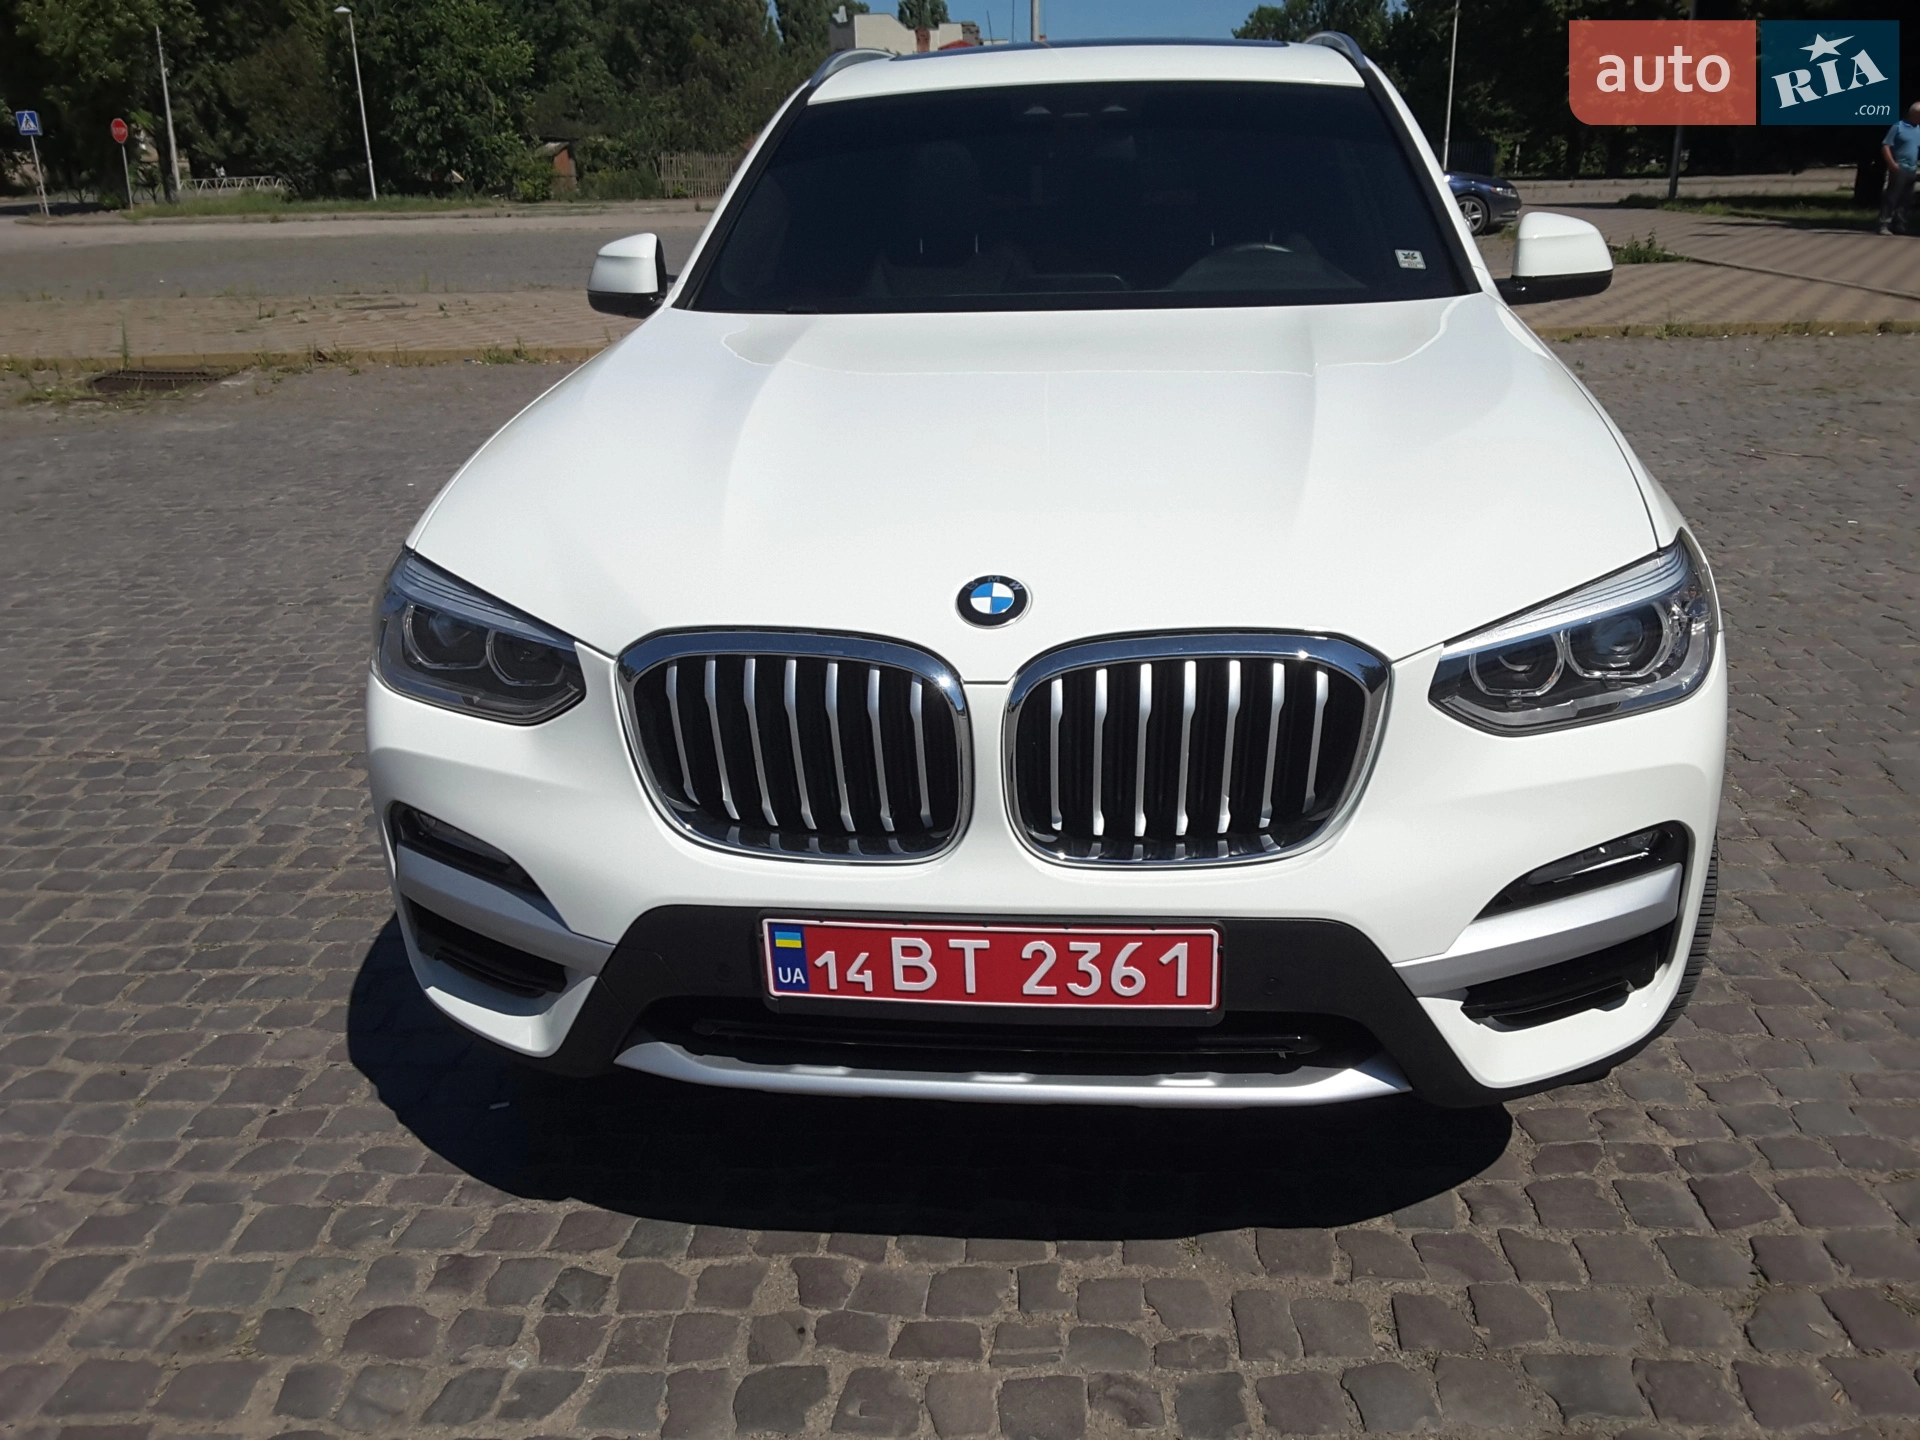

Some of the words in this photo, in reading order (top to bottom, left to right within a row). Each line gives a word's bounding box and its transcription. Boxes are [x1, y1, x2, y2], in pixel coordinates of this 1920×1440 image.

[965, 576, 1023, 591] BMW
[778, 966, 806, 985] UA
[814, 950, 873, 993] 14
[891, 937, 990, 994] BT
[1021, 941, 1189, 997] 2361
